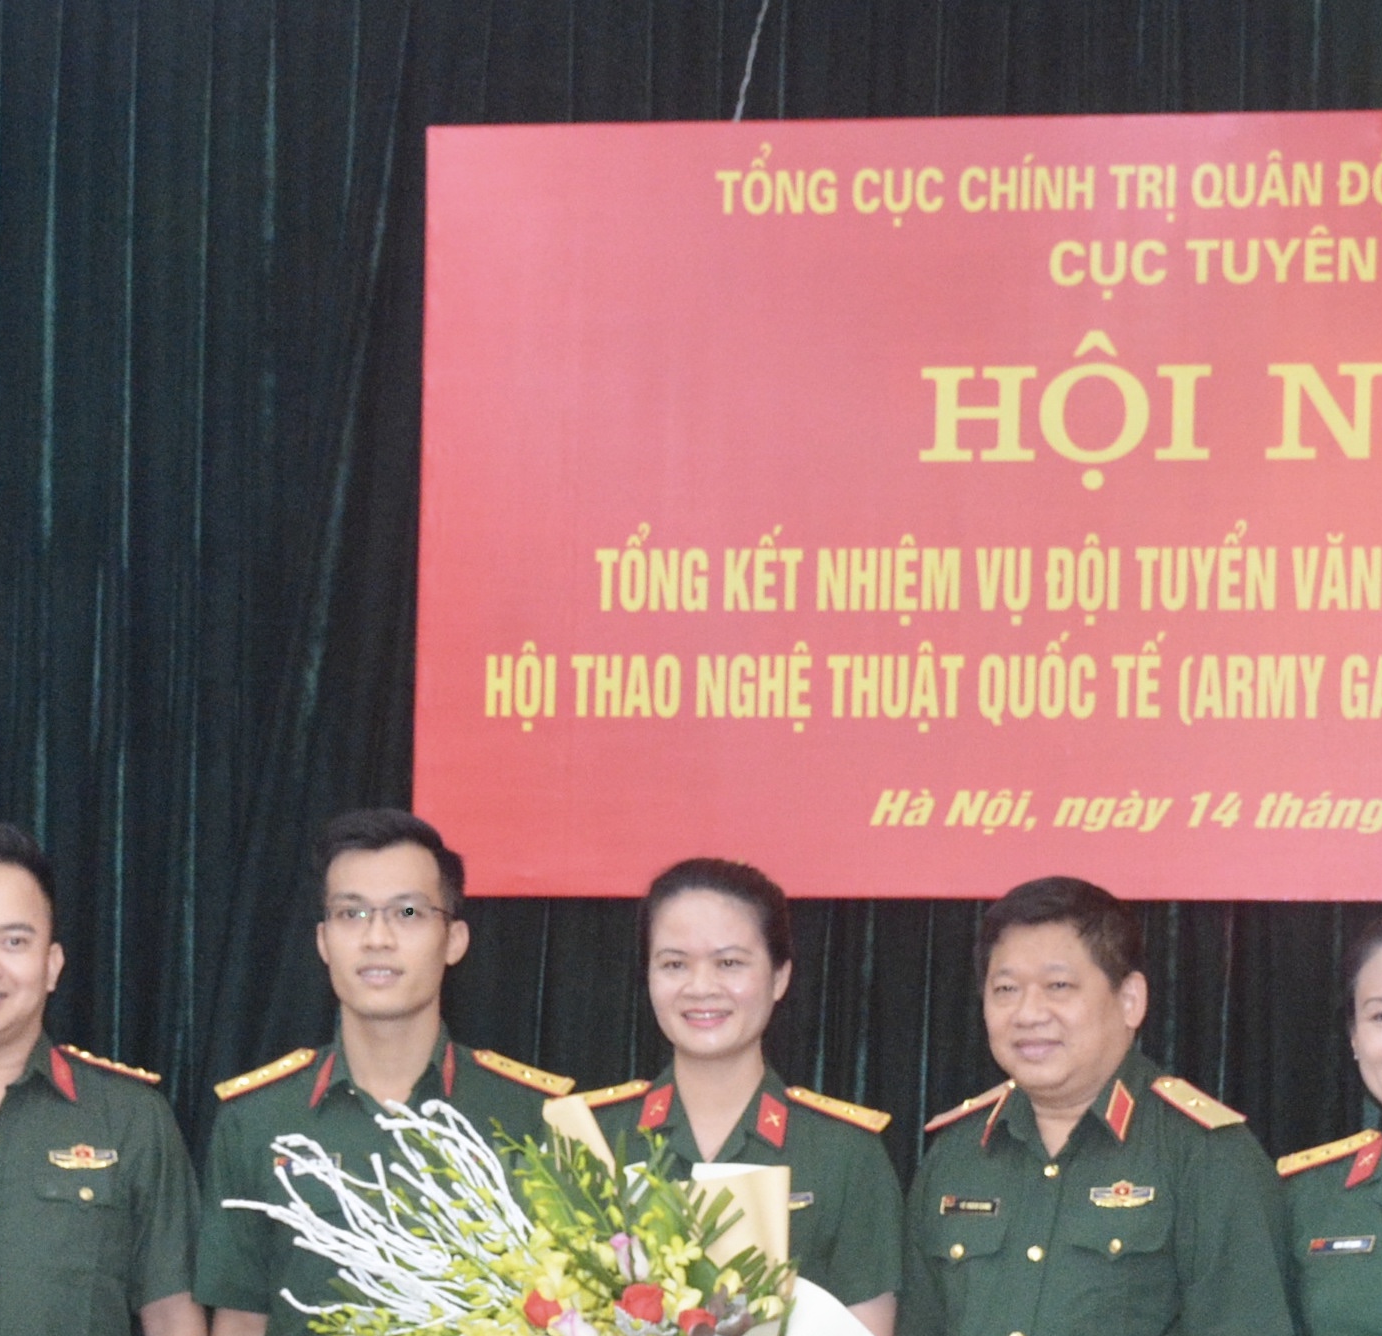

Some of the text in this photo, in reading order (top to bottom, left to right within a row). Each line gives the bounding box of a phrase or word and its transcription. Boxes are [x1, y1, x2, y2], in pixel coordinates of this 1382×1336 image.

[715, 142, 839, 216] TỔNG
[852, 166, 945, 228] CỤC
[958, 153, 1096, 213] CHÍNH
[1109, 164, 1177, 223] TRỊ
[1191, 149, 1325, 209] QUÂN
[1049, 238, 1168, 301] CỤC
[1185, 223, 1380, 286] TUYÊN
[918, 328, 1214, 492] HỘI
[594, 521, 710, 613] TỔNG
[723, 524, 806, 613] KẾT
[815, 532, 963, 628] NHIỆM
[974, 545, 1034, 627] VỤ
[1044, 531, 1122, 627] ĐỘI
[1134, 518, 1279, 613] TUYỂN
[483, 639, 558, 734] HỘI
[569, 653, 683, 720] THAO
[695, 639, 815, 734] NGHỆ
[826, 639, 967, 735] THUẬT
[977, 630, 1099, 727] QUỐC
[1110, 630, 1167, 720] TẾ
[1178, 653, 1328, 726] (ARMY
[869, 787, 937, 828] Hà
[944, 788, 1038, 836] Nội,
[1052, 789, 1175, 834] ngày
[1187, 790, 1243, 829] 14
